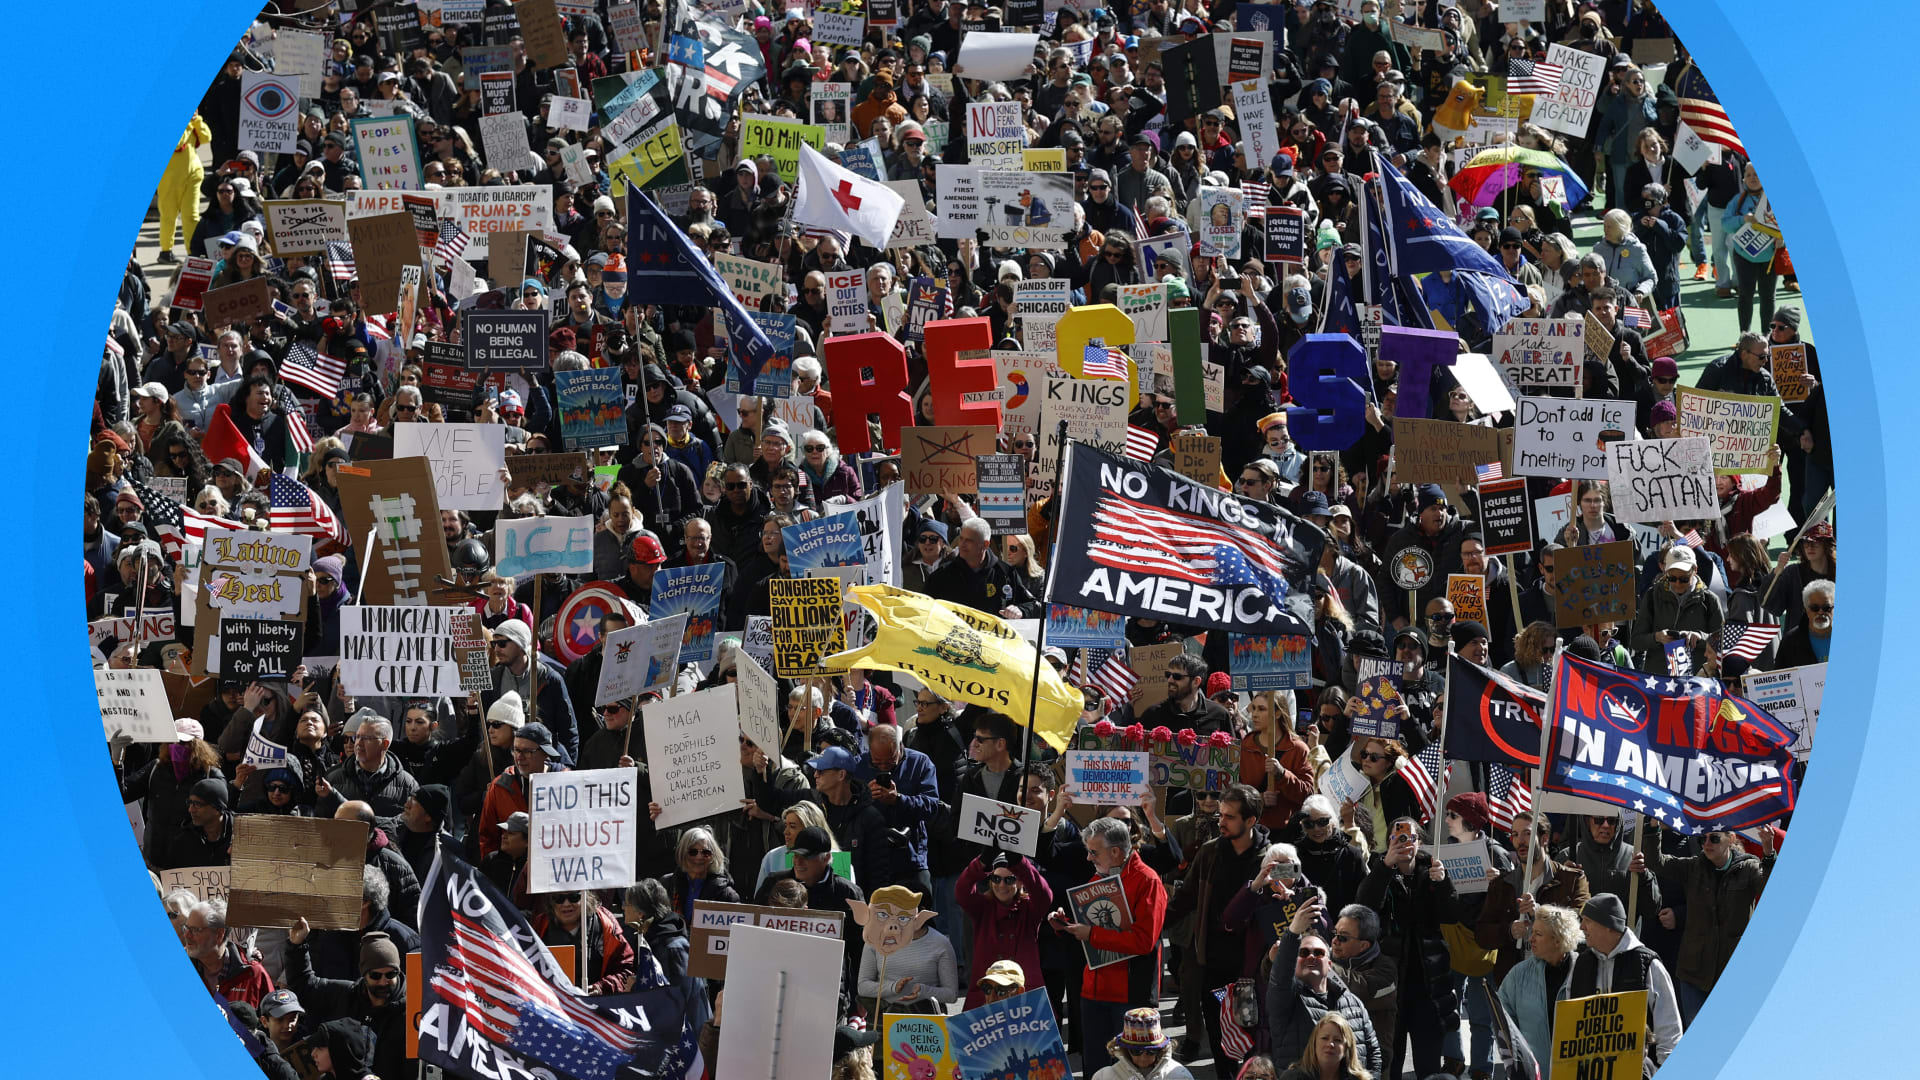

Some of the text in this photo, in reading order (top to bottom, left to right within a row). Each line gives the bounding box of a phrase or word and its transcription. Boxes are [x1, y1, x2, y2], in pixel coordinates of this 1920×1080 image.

[1553, 50, 1593, 71] MAKE
[483, 82, 511, 90] TRUMP
[824, 84, 841, 92] END
[812, 91, 850, 99] OPERATION
[1235, 91, 1268, 107] PEOPLE
[972, 105, 1019, 137] NO KINGS
[1243, 109, 1265, 120] HAVE
[1536, 101, 1588, 127] AGAIN
[242, 119, 296, 132] MAKE ORWELL
[248, 130, 291, 141] FICTION
[360, 129, 401, 139] PEOPLE
[253, 141, 282, 150] AGAIN
[969, 142, 996, 155] HANDS
[371, 163, 408, 174] KINGS
[492, 192, 537, 202] OLIGARCHY
[462, 204, 532, 217] TRUMP'S
[275, 227, 344, 238] CONSTITUTION,
[1209, 226, 1235, 235] LOSER
[1268, 226, 1299, 235] LARGUE
[734, 278, 762, 292] DUE
[828, 274, 863, 289] ICE
[1017, 281, 1066, 291] HANDS OFF
[836, 287, 857, 300] OUT
[1123, 285, 1159, 296] FIGHT
[831, 303, 865, 317] CITIES
[1017, 302, 1066, 313] CHICAGO
[475, 323, 537, 334] NO HUMAN
[769, 319, 785, 328] UP
[1496, 321, 1583, 337] IMMIGRANTS
[489, 336, 523, 346] BEING
[475, 349, 538, 360] IS ILLEGAL
[1499, 350, 1575, 366] AMERICA
[569, 375, 591, 385] RISE
[562, 383, 619, 396] FIGHT BACK
[987, 391, 1005, 401] ICE
[1047, 379, 1125, 407] KINGS
[1520, 400, 1622, 426] Dont add ice
[1756, 403, 1773, 419] UP
[1400, 421, 1417, 434] IF
[1537, 426, 1584, 443] to a
[418, 427, 473, 458] WE
[1179, 438, 1215, 453] Little
[1520, 451, 1608, 472] melting pot
[1615, 440, 1682, 474] FUCK
[427, 459, 464, 475] THE
[909, 472, 934, 490] NO
[1631, 474, 1713, 513] SATAN
[1101, 462, 1297, 550] NO KINGS IN
[1484, 505, 1524, 518] LARGUE
[1487, 517, 1522, 529] TRUMP
[799, 522, 846, 542] RISE UP
[212, 537, 301, 569] Latino
[497, 525, 593, 576] ICE
[793, 533, 857, 557] FIGHT BACK
[667, 574, 711, 587] RISE UP
[770, 579, 839, 597] CONGRESS:
[218, 573, 284, 605] Heat
[657, 583, 718, 601] FIGHT BACK
[1079, 566, 1300, 625] AMERICA
[771, 596, 840, 606] SAY NO TO
[450, 614, 472, 622] STOP
[772, 604, 842, 628] BILLIONS
[1582, 601, 1629, 620] OTHER
[225, 622, 297, 641] with liberty
[951, 609, 1017, 641] TREAD
[453, 639, 487, 648] WOMEN
[774, 630, 793, 644] FOR
[226, 637, 290, 658] and justice
[343, 635, 390, 662] MAKE
[775, 642, 815, 653] WAR
[1150, 649, 1167, 659] ARE
[233, 656, 288, 674] for ALL
[1391, 661, 1403, 675] ICE
[1753, 673, 1792, 686] HANDS OFF
[116, 688, 131, 697] AND
[459, 684, 492, 692] WRONG
[667, 709, 701, 729] MAGA
[1352, 726, 1376, 736] CHICAGO
[663, 734, 717, 756] PEDOPHILES
[672, 750, 709, 767] RAPISTS
[1082, 760, 1133, 770] THIS WHAT
[1559, 715, 1781, 803] IN AMERICA
[664, 760, 722, 781] COP-KILLERS
[1082, 770, 1132, 782] DEMOCRACY
[1169, 759, 1241, 792] SORRY
[669, 774, 709, 792] LAWLESS
[1082, 783, 1132, 792] LOOKS LIKE
[535, 781, 632, 812] END THIS
[662, 784, 726, 808] UN-AMERICAN
[975, 810, 1021, 836] NO
[540, 820, 625, 850] UNJUST
[973, 826, 1020, 846] KINGS
[551, 856, 605, 883] WAR
[170, 871, 185, 886] I
[1075, 882, 1119, 904] NO KINGS
[701, 913, 838, 935] MAKE AMERICA
[446, 872, 652, 1033] NO IN
[1583, 996, 1619, 1019] FUND
[969, 1005, 1034, 1035] RISE UP
[1575, 1013, 1625, 1039] PUBLIC
[895, 1023, 935, 1034] IMAGINE
[910, 1034, 940, 1045] BEING
[962, 1019, 1051, 1057] FIGHT BACK
[1559, 1031, 1638, 1060] EDUCATION
[914, 1045, 943, 1054] MAGA
[1575, 1055, 1618, 1080] NOT
